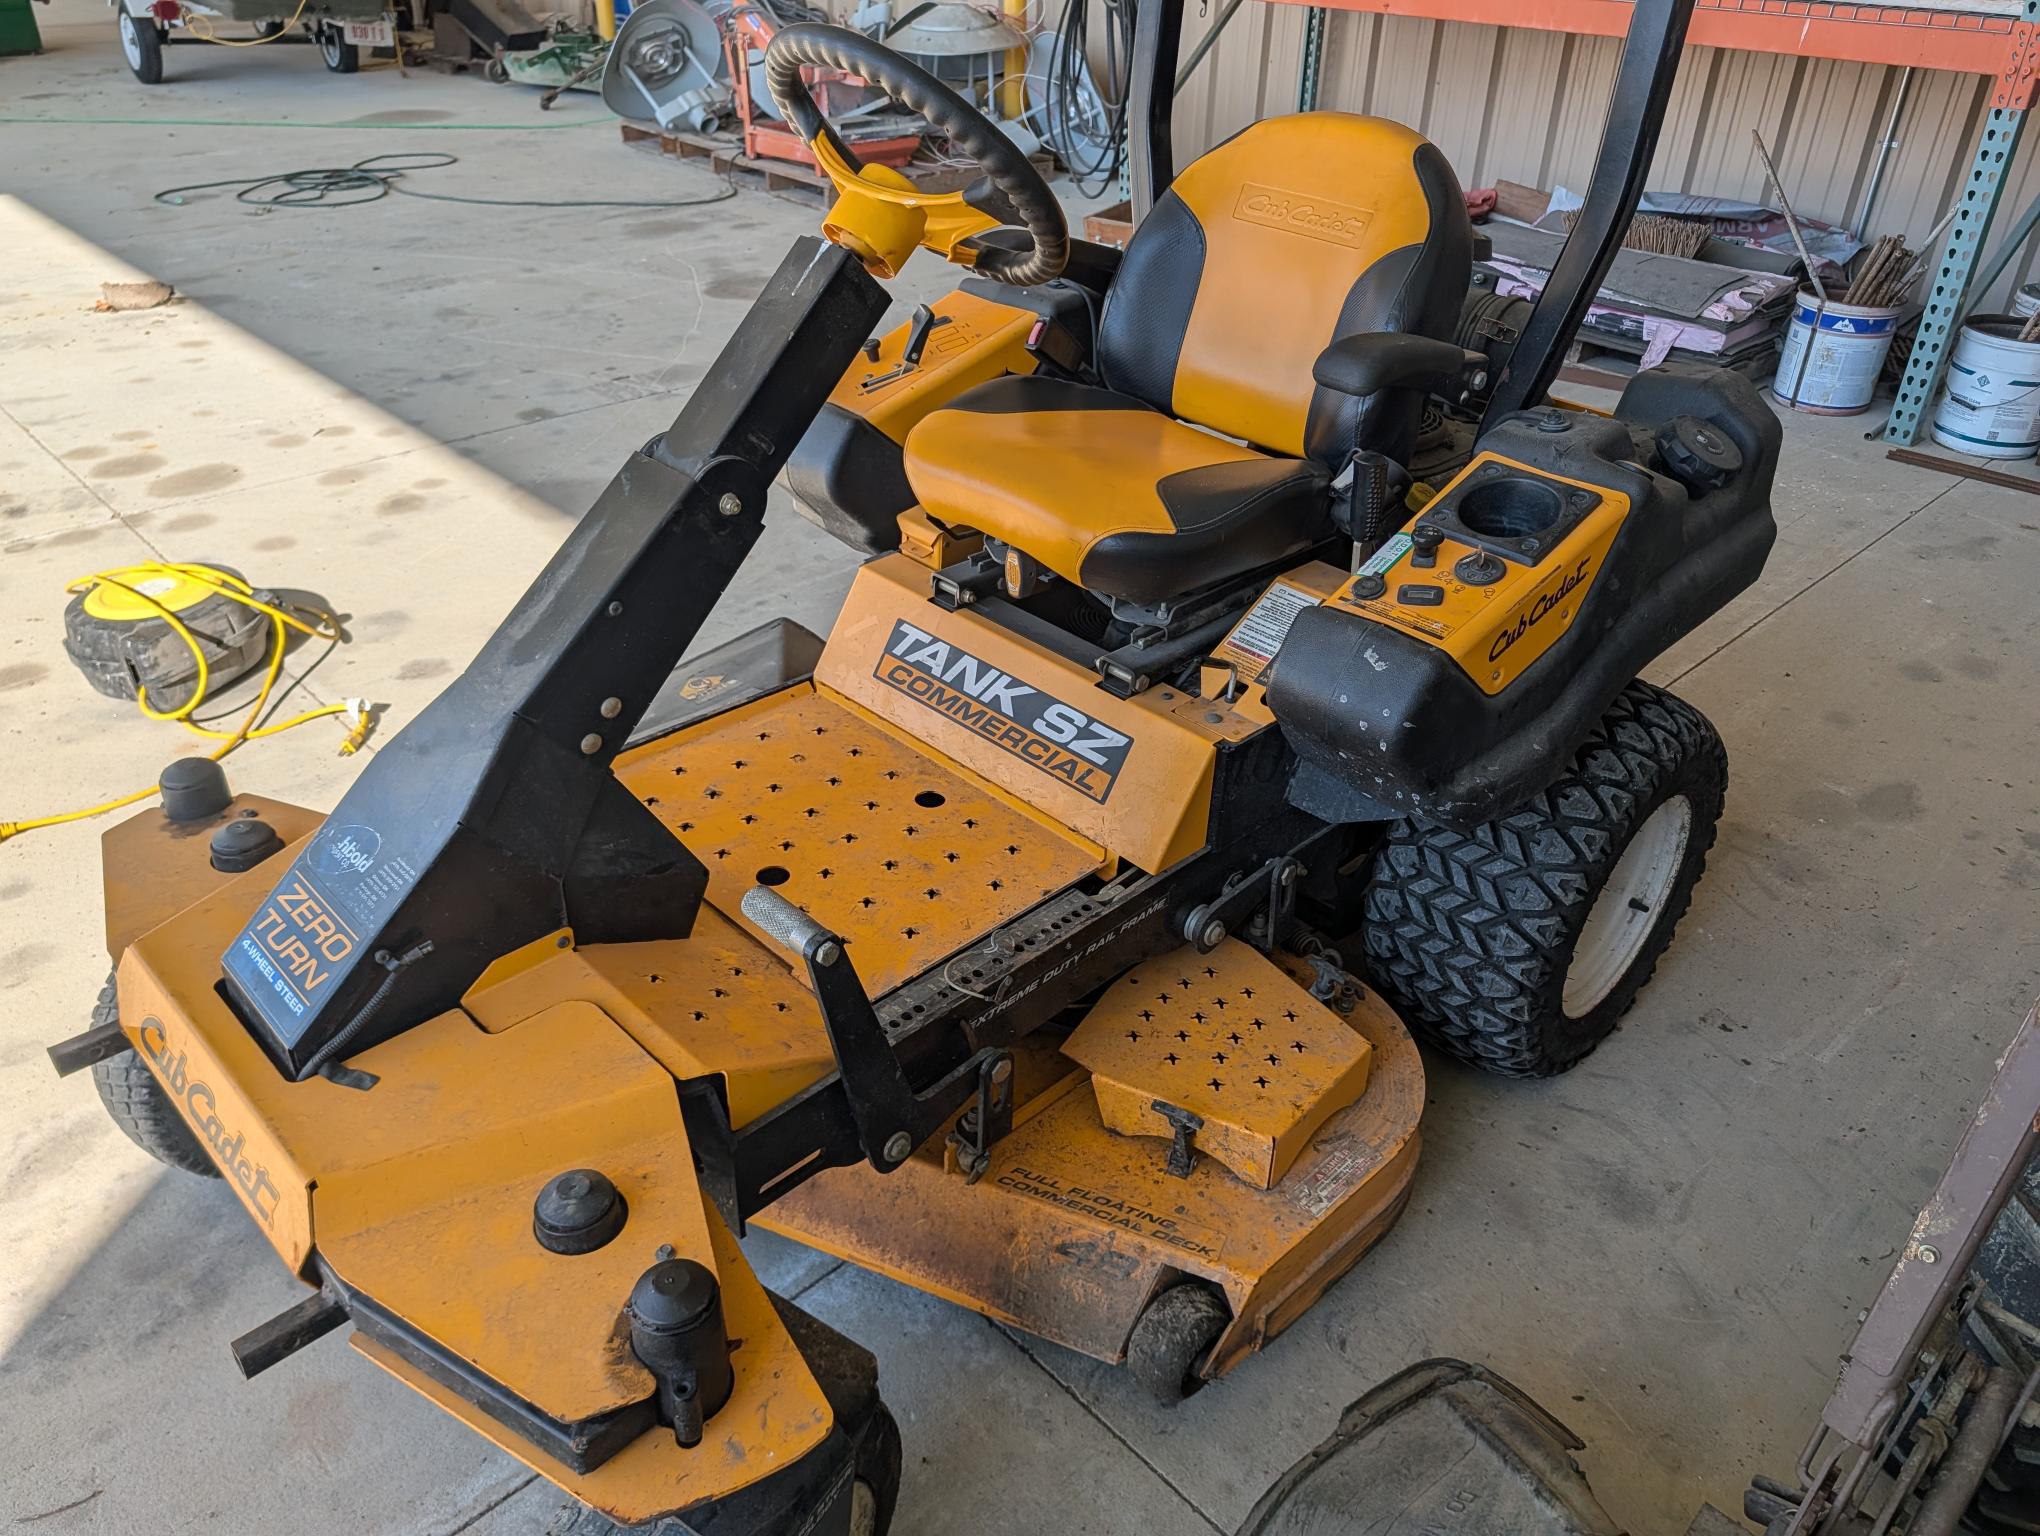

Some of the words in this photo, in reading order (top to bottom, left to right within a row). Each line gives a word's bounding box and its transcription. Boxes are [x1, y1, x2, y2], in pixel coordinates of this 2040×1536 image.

[1243, 194, 1289, 221] Cub
[1288, 205, 1366, 239] Cadet
[1711, 220, 1769, 234] ARM
[1488, 612, 1527, 662] Cub
[1528, 556, 1592, 627] Cadet
[887, 665, 1096, 792] COMMERCIAL
[891, 622, 1038, 718] TANK
[1032, 703, 1130, 766] SZ
[338, 836, 374, 873] hbold
[256, 907, 330, 991] TURN
[276, 882, 353, 962] ZERO
[968, 978, 1042, 1029] EXTREME
[1043, 950, 1085, 984] DUTY
[1085, 932, 1117, 957] RAIL
[1119, 898, 1169, 934] FRAME
[242, 938, 277, 983] 4-WHEEL
[274, 979, 304, 1017] STEER
[140, 1015, 187, 1096] Cub
[186, 1081, 280, 1223] Cadet
[997, 1175, 1143, 1233] COMMERCIAL
[1150, 1229, 1218, 1258] DECK
[1010, 1166, 1062, 1190] FULL
[1067, 1186, 1179, 1230] FLOATING
